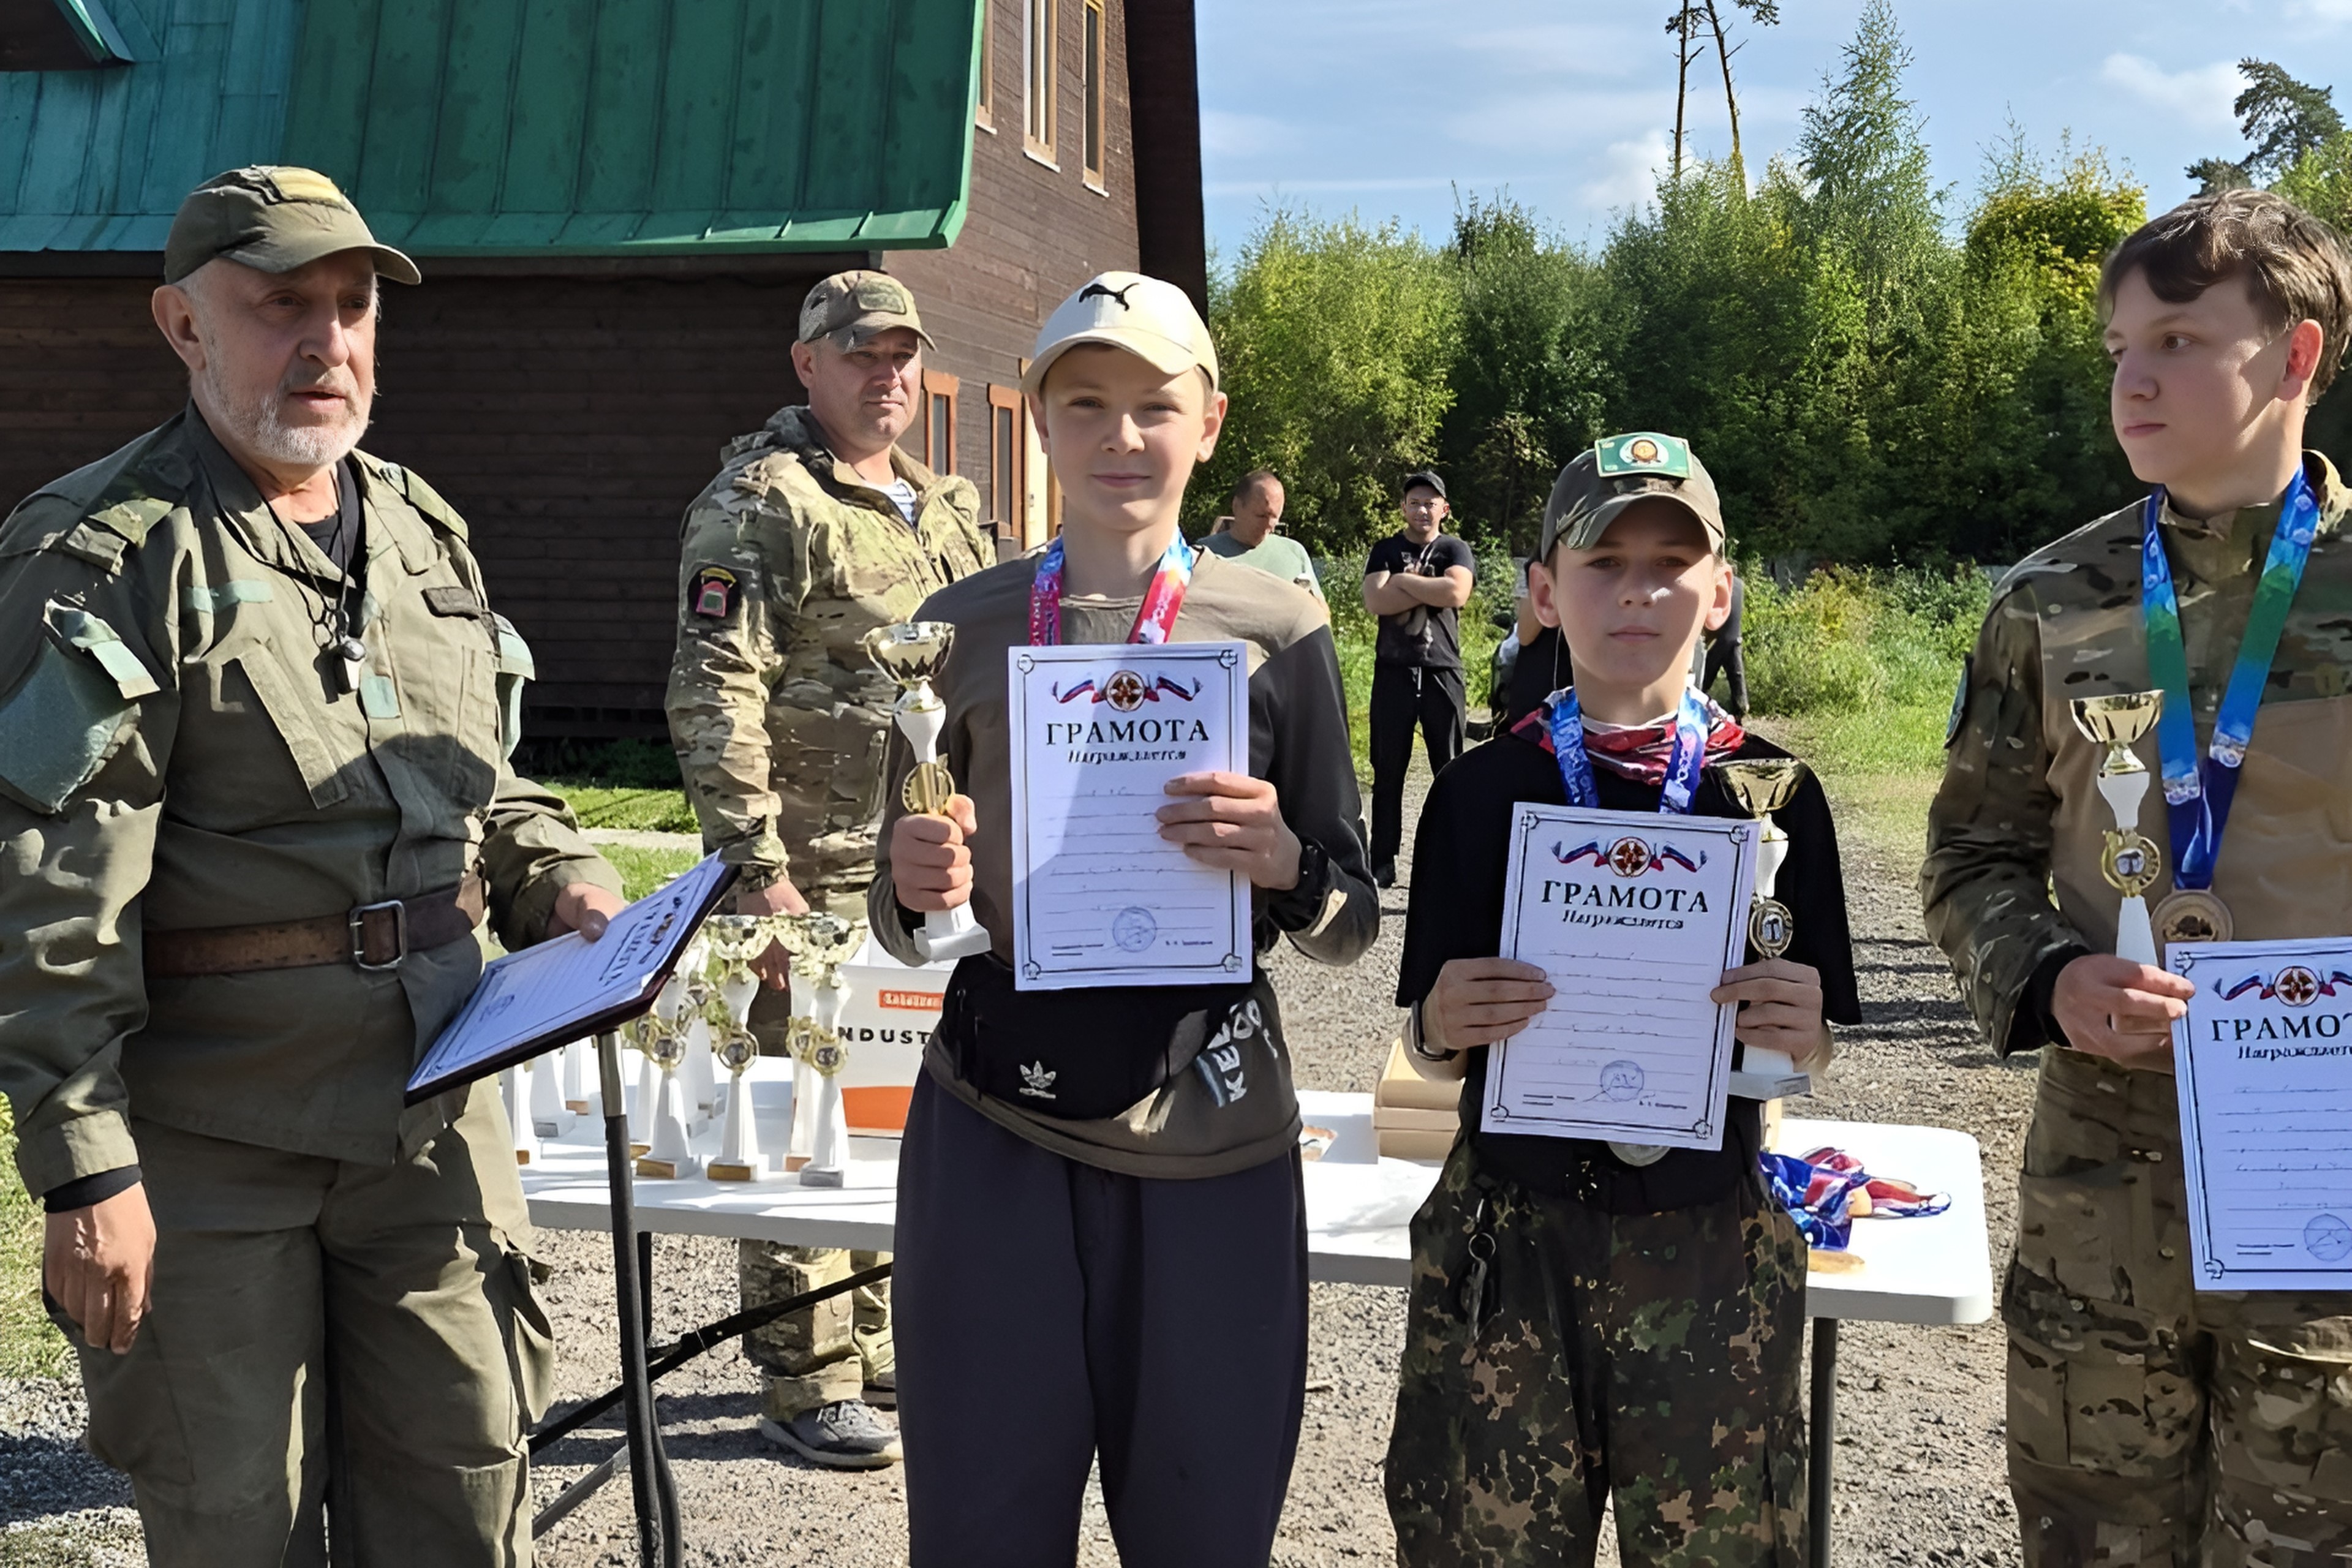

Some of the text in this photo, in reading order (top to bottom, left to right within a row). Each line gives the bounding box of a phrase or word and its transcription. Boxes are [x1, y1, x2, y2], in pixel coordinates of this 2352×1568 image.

[1046, 719, 1209, 745] ГРАМОТА
[1542, 880, 1709, 913] ГРАМОТА
[837, 1027, 932, 1044] NDUST
